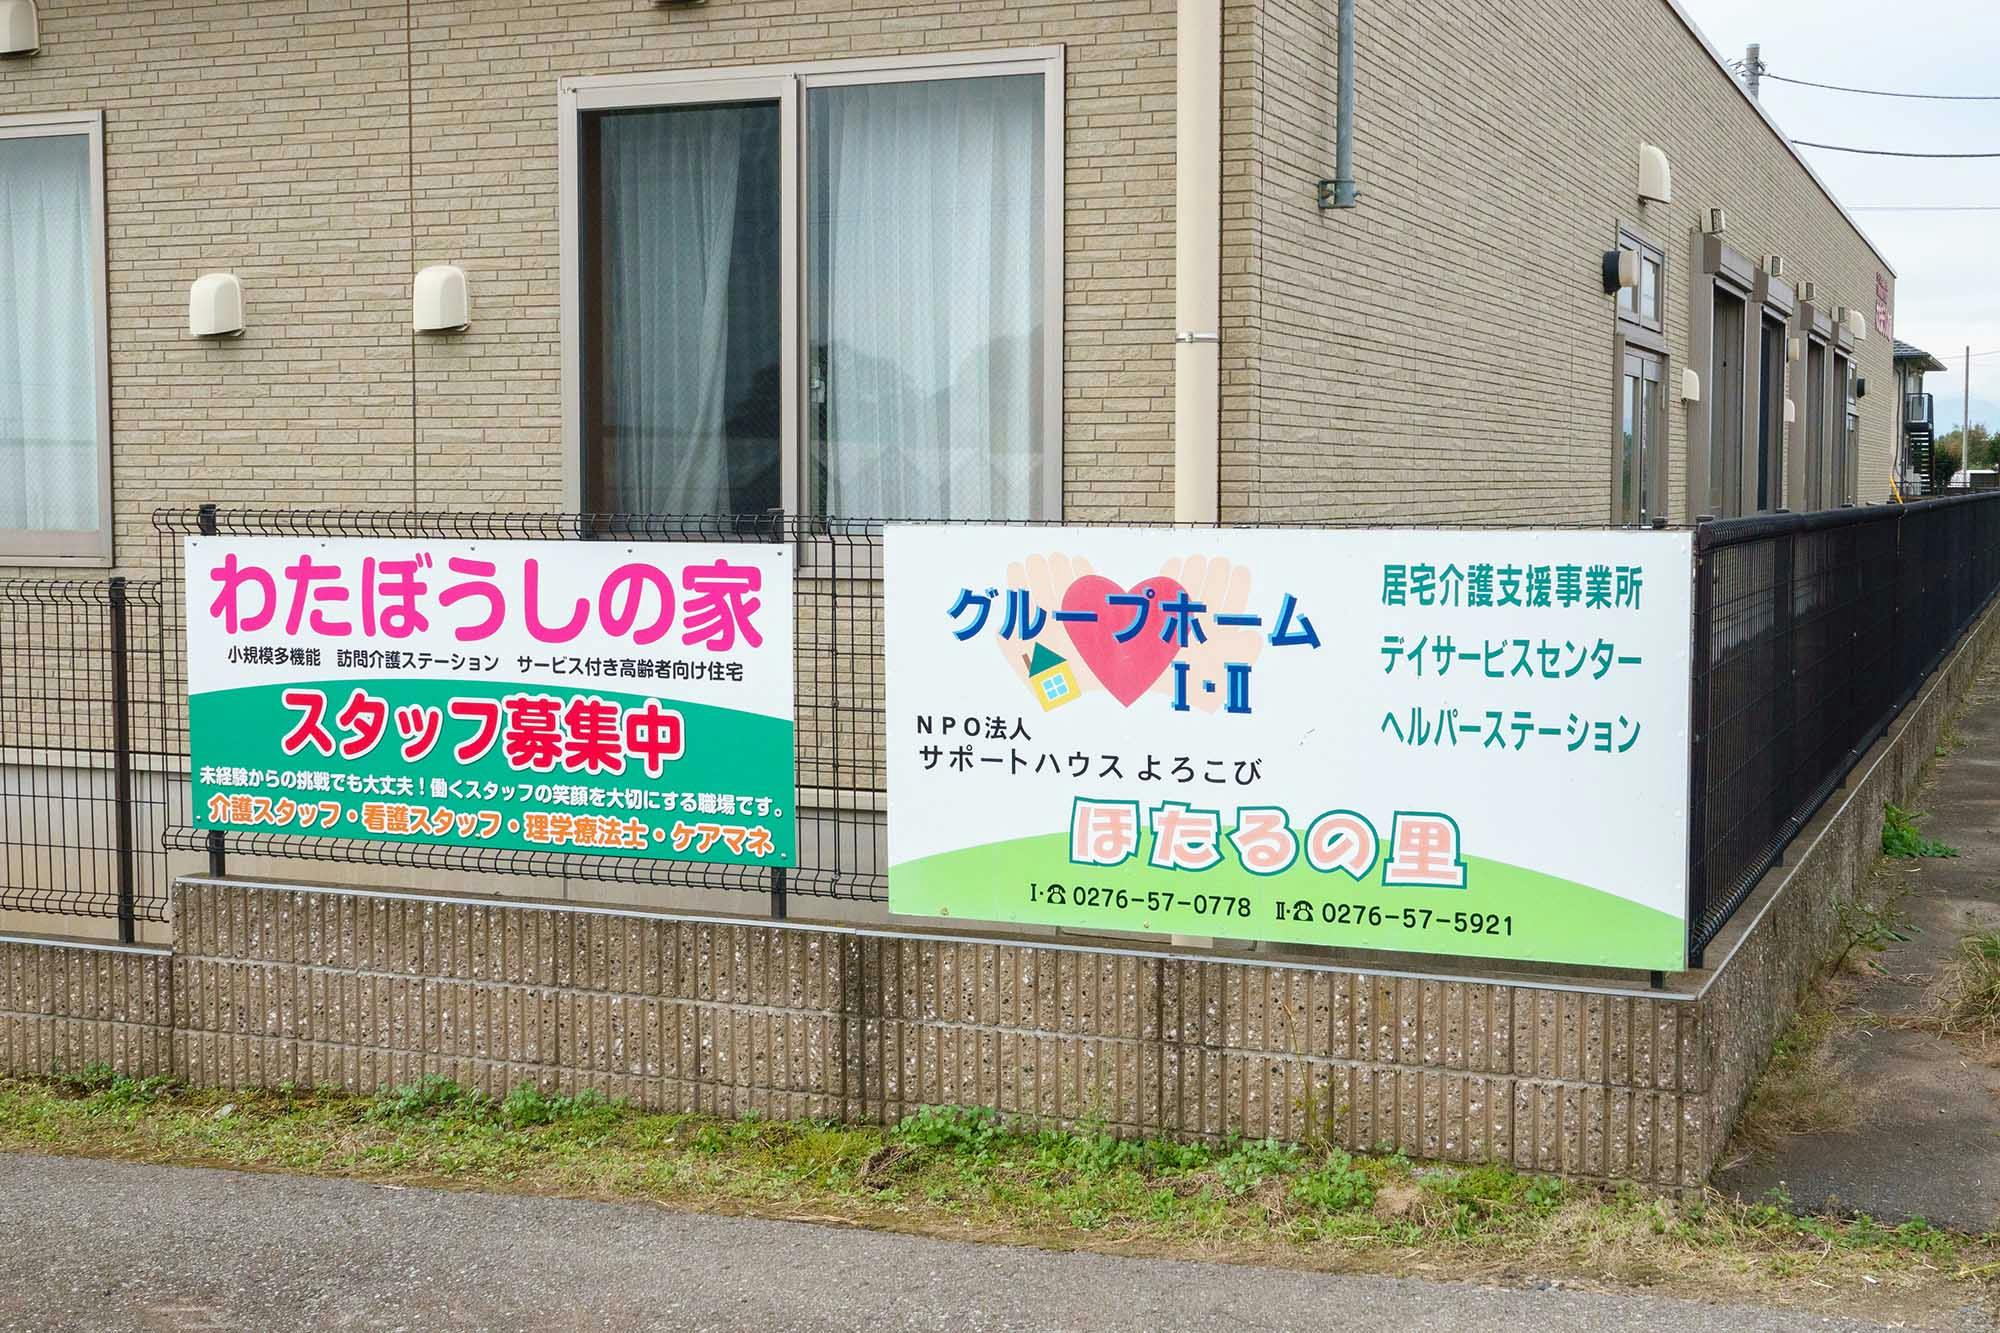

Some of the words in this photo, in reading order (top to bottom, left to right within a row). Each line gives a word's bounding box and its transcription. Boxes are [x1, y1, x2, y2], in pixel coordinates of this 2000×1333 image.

[210, 553, 763, 652] わたぼうしの家
[1381, 563, 1643, 610] 居宅介護支援事業所
[947, 587, 1321, 650] グループホーム
[227, 645, 321, 667] 小規模多機能
[337, 649, 499, 672] 訪問介護ステーション
[517, 655, 744, 682] サービス付き高齢者向け住宅
[1381, 635, 1643, 681] デイサービスセンター
[283, 689, 685, 777] スタッフ募集中
[916, 715, 1032, 741] NPO法人
[1381, 706, 1642, 754] ヘルパーステーション
[919, 744, 1124, 780] サポートハウス
[1138, 754, 1263, 785] よろこび
[1069, 796, 1468, 889] ほたるの里
[1073, 886, 1252, 918] 0276-57-0778
[1322, 902, 1514, 937] 0276-57-5921
